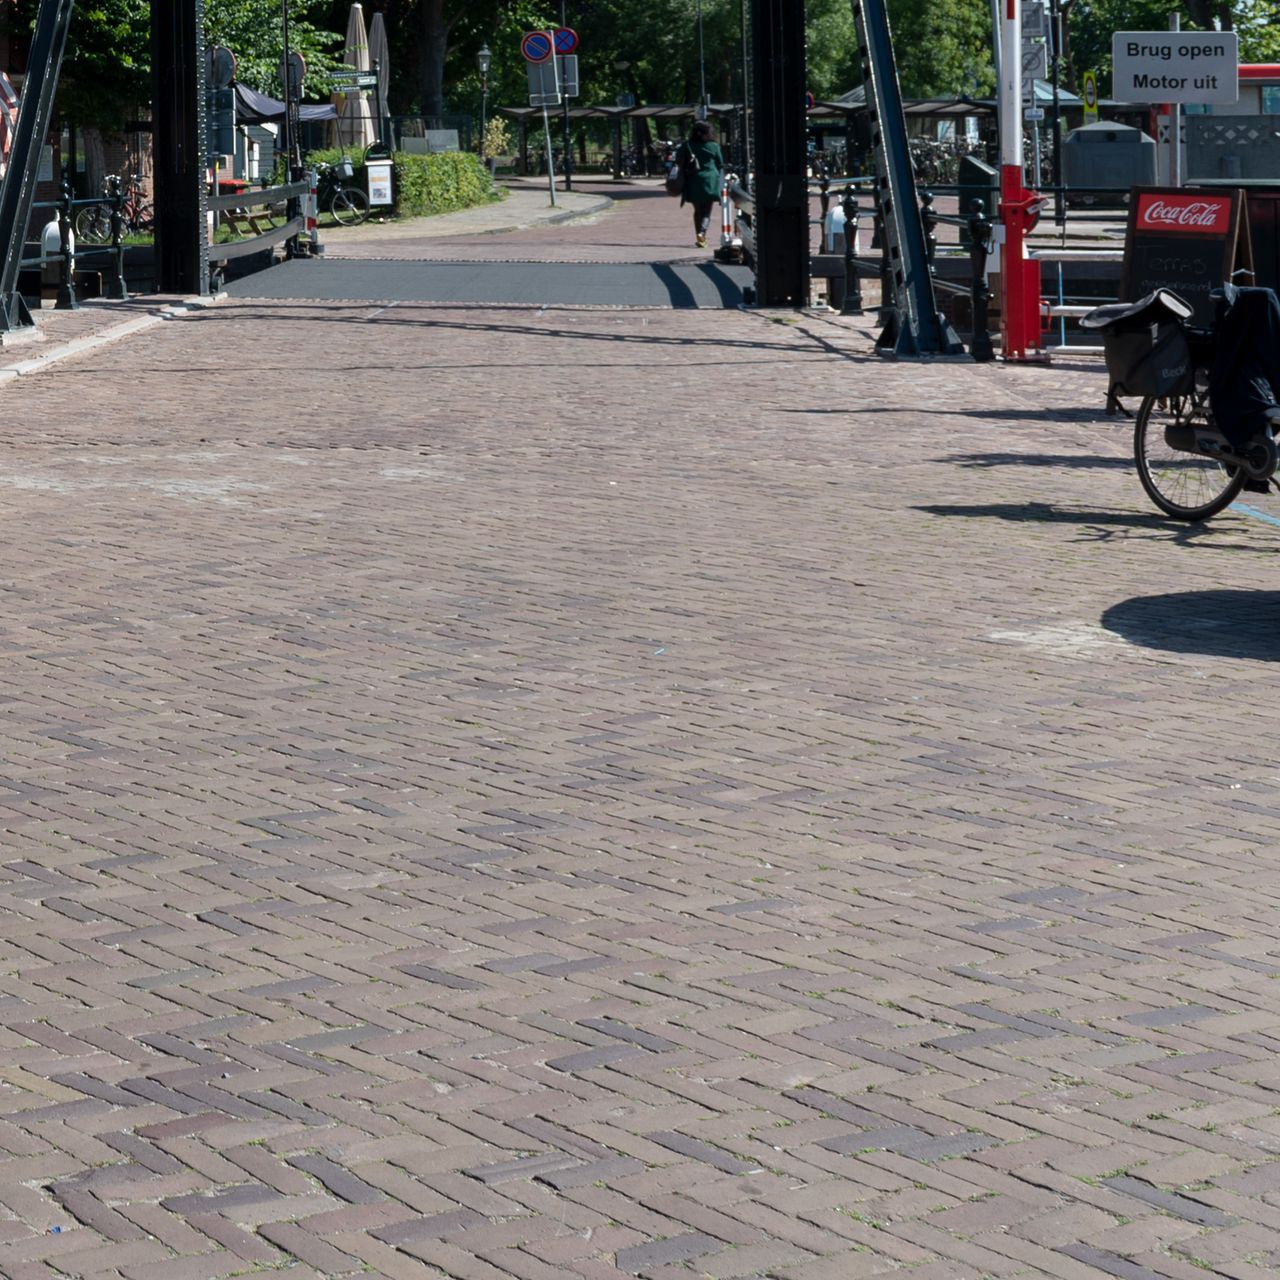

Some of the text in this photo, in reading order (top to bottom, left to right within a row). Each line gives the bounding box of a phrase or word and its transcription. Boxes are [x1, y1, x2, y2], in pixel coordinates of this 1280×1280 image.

[1127, 42, 1224, 60] Brug open
[1133, 74, 1217, 89] Motor uit
[1144, 201, 1222, 225] Coca-Cola
